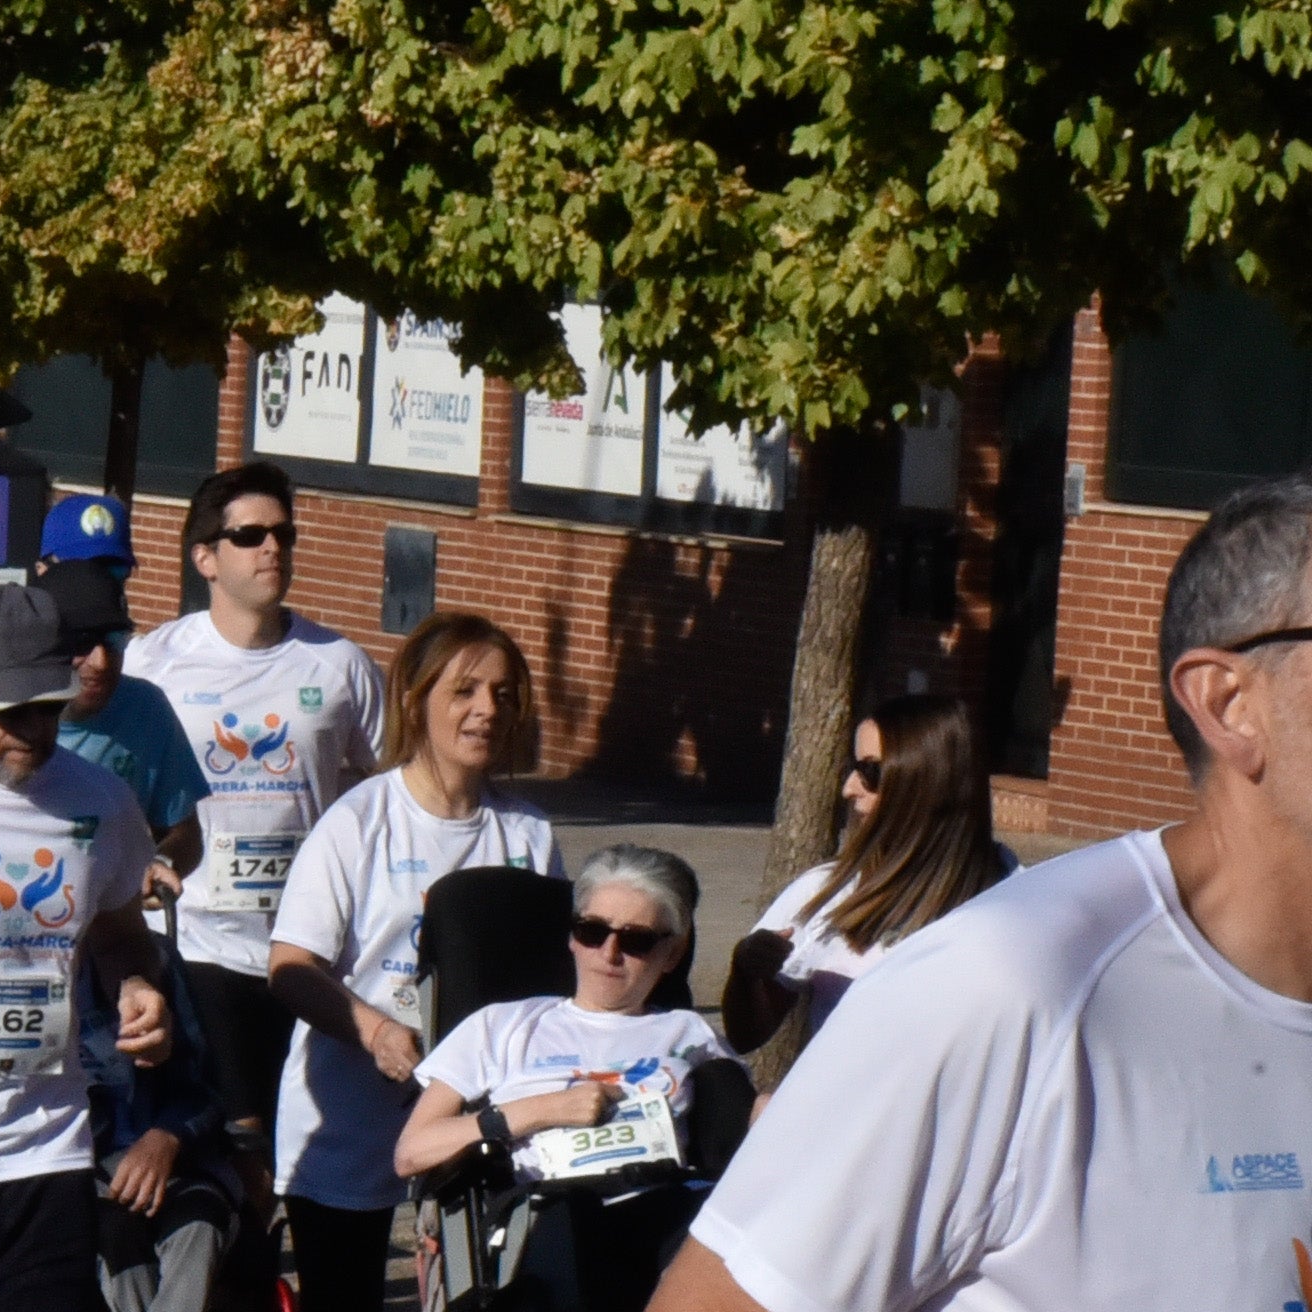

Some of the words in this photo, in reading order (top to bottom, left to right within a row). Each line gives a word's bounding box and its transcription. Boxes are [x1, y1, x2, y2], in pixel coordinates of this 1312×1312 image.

[409, 389, 471, 425] FEDHIELO
[230, 857, 293, 878] 1747
[381, 959, 420, 976] CAR
[571, 1125, 636, 1152] 323
